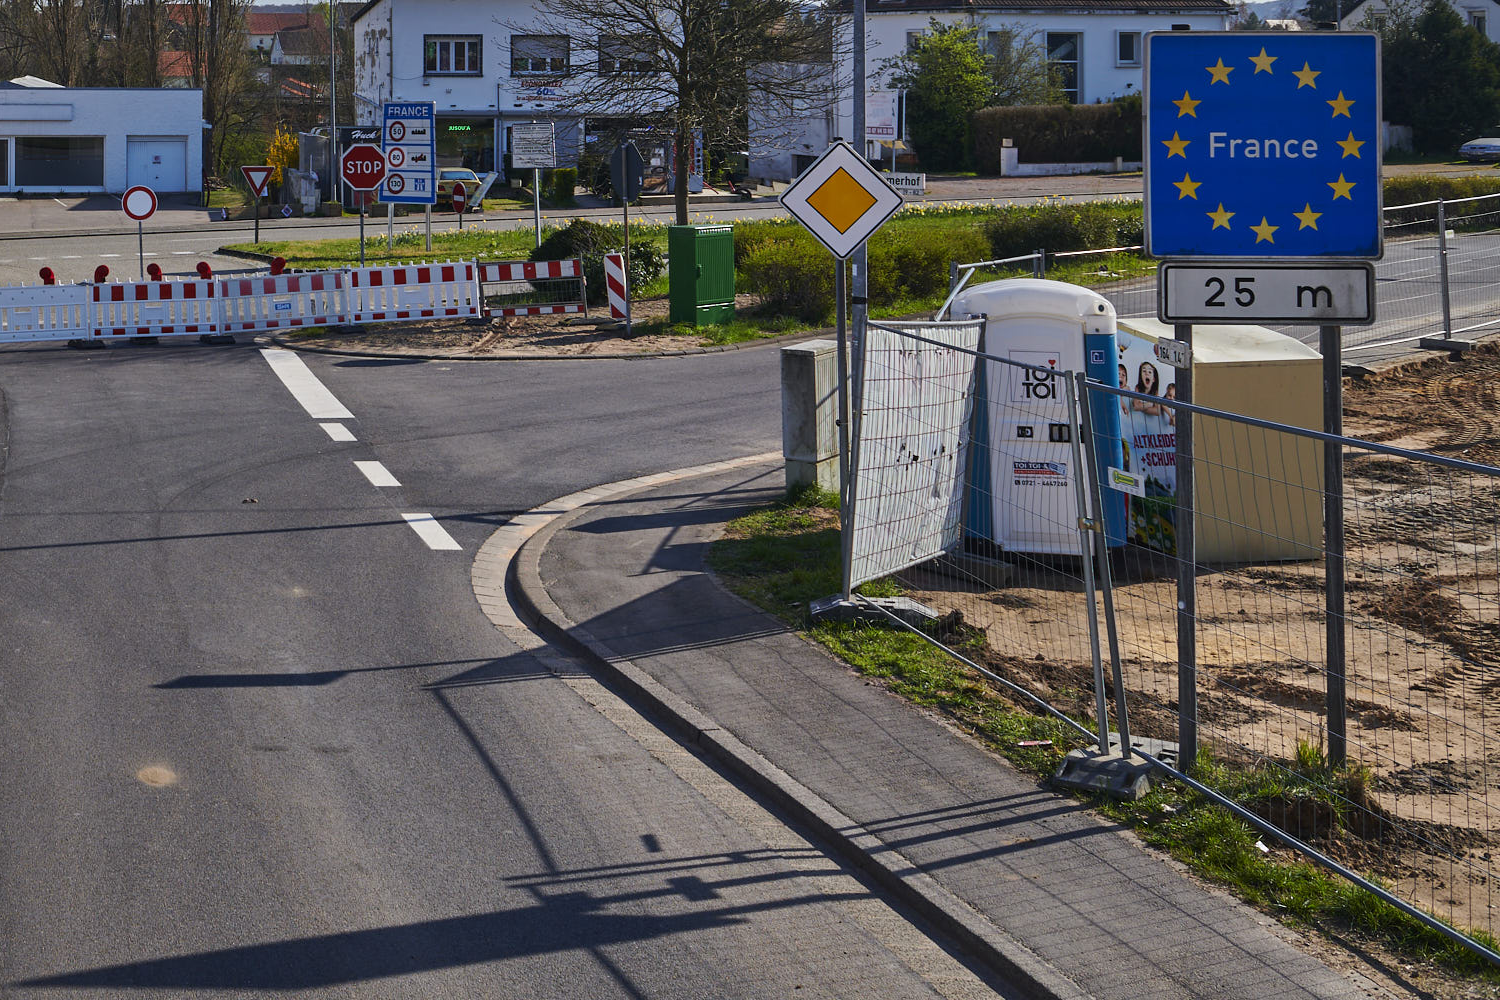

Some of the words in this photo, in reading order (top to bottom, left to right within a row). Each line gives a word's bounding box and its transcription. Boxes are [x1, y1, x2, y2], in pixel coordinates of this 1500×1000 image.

[387, 106, 429, 117] FRANCE
[1209, 131, 1319, 159] France
[346, 160, 382, 174] STOP
[887, 176, 921, 186] merhof
[1204, 276, 1256, 307] 25
[1296, 285, 1332, 308] m
[1022, 383, 1056, 399] TOI
[1133, 434, 1176, 449] ALTKLEIDE
[1140, 452, 1176, 466] +SCHUH
